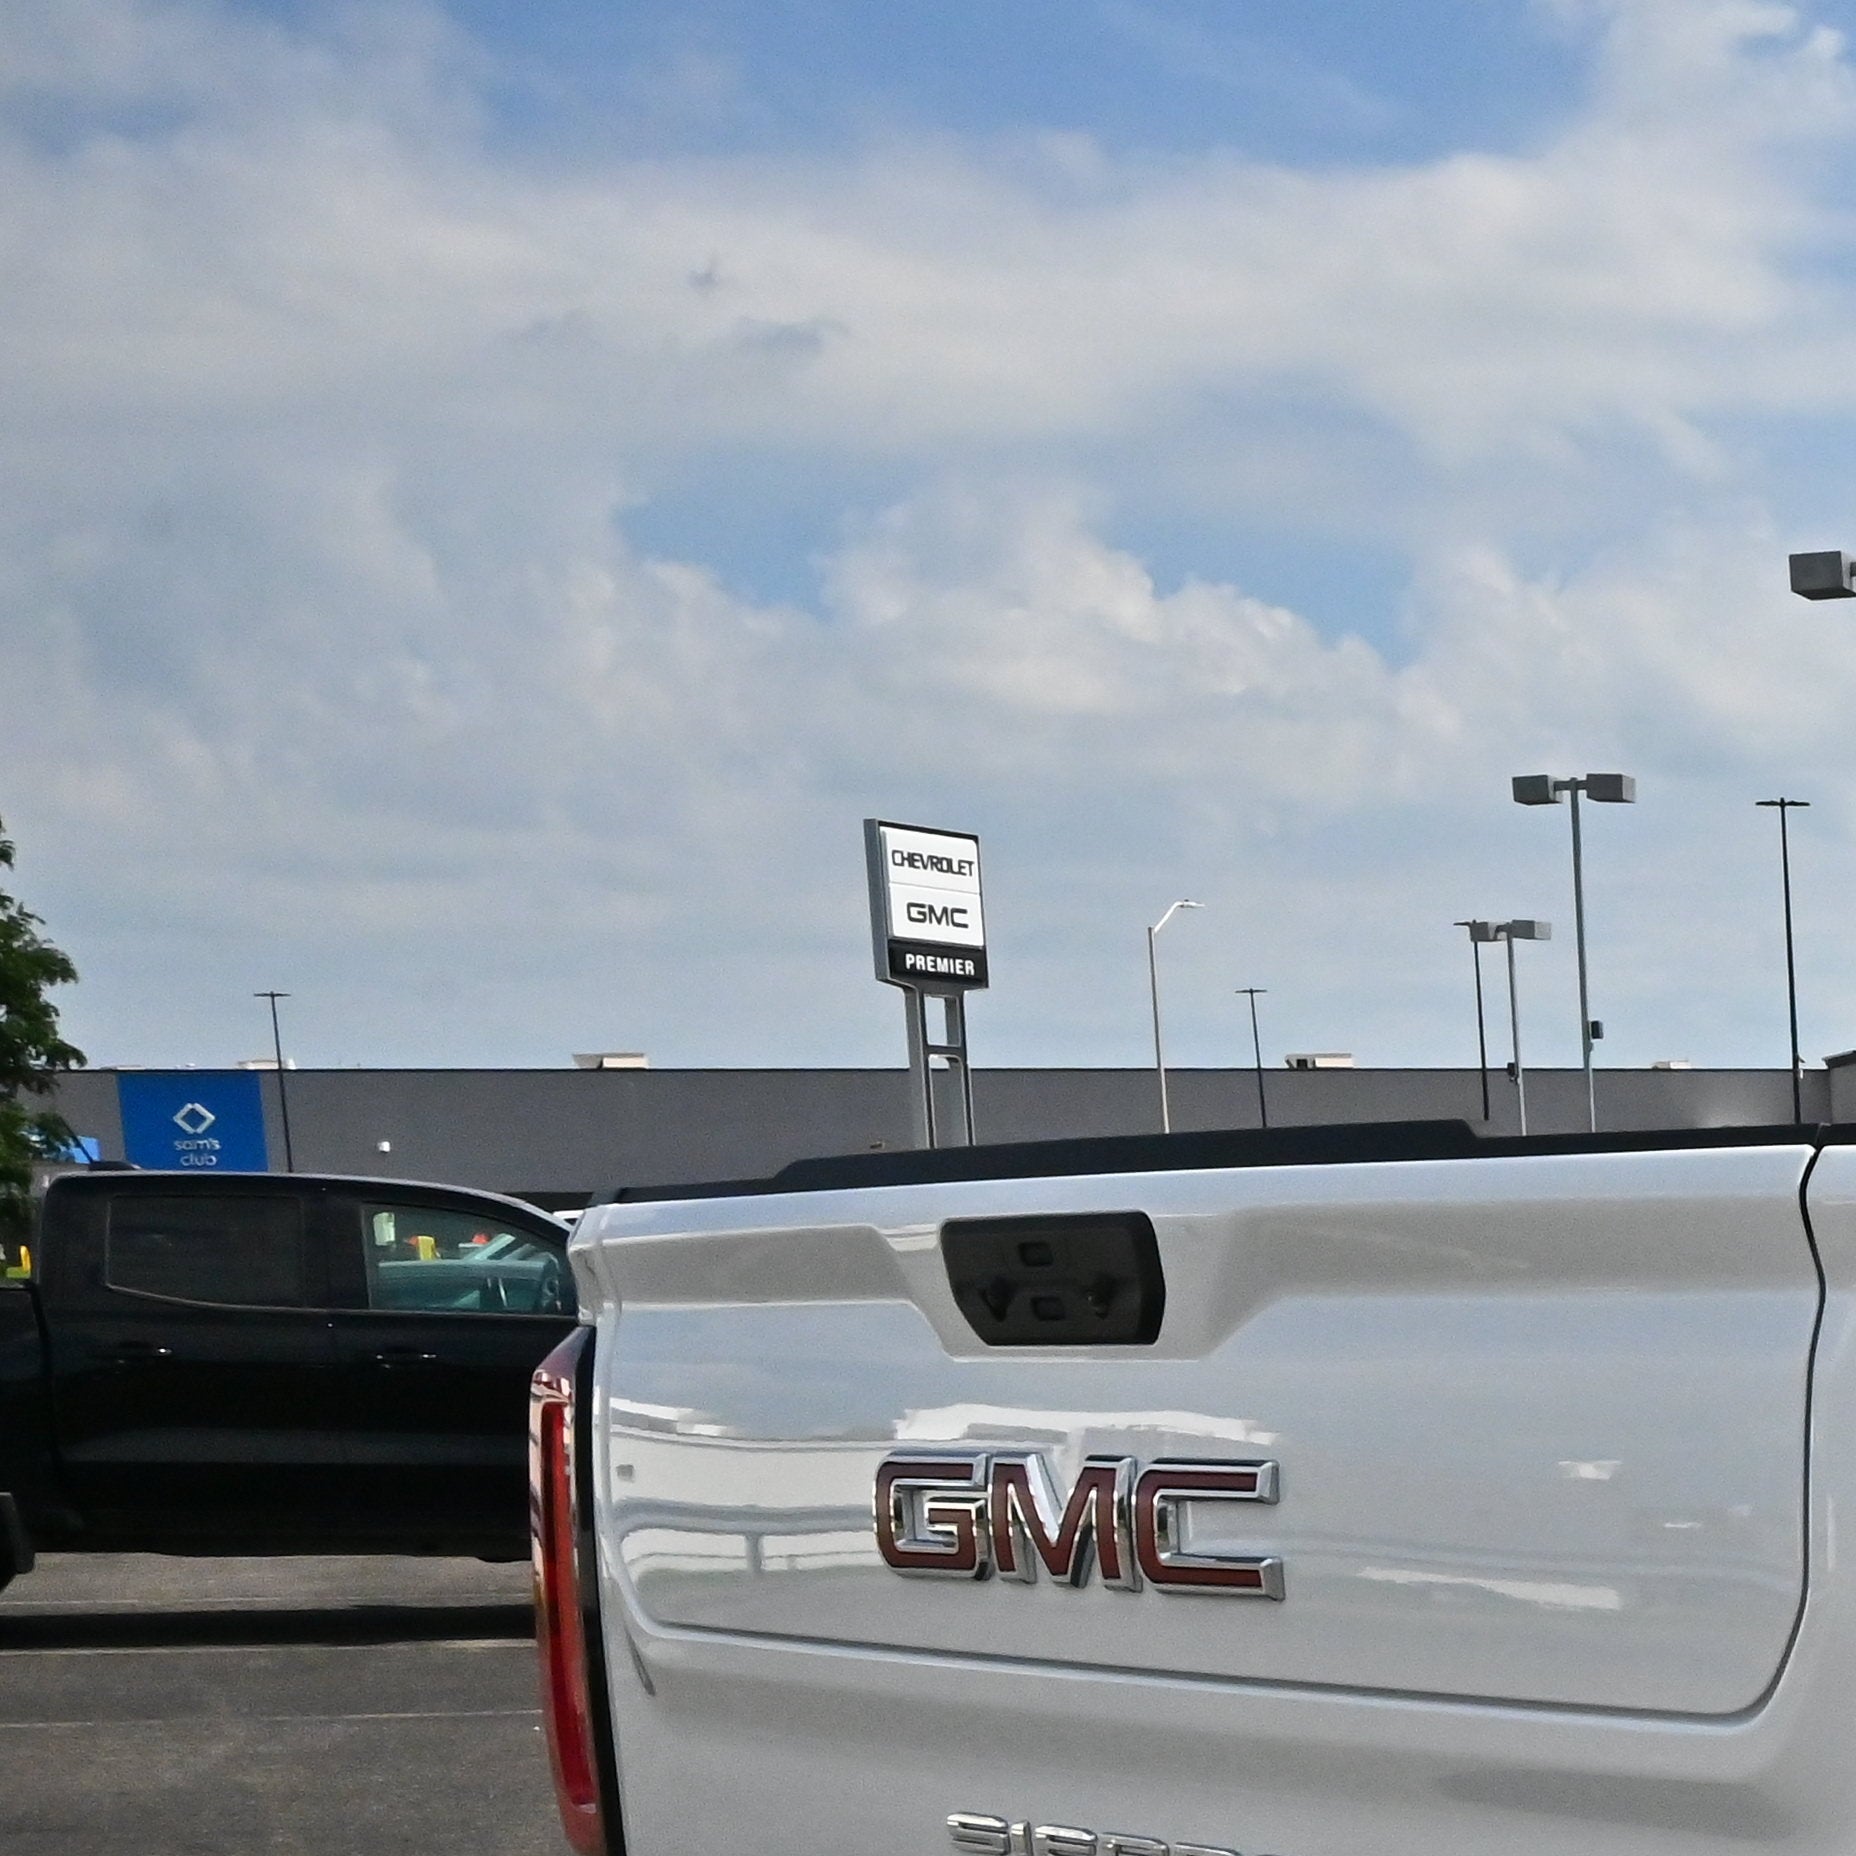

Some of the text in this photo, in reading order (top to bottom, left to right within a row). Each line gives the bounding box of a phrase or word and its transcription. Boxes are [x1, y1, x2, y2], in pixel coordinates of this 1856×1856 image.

[891, 849, 974, 876] CHEVROLET
[906, 902, 969, 929] GMC
[905, 953, 975, 976] PREMIER
[174, 1138, 221, 1150] sam's
[180, 1153, 217, 1167] club
[873, 1449, 1285, 1600] GMC
